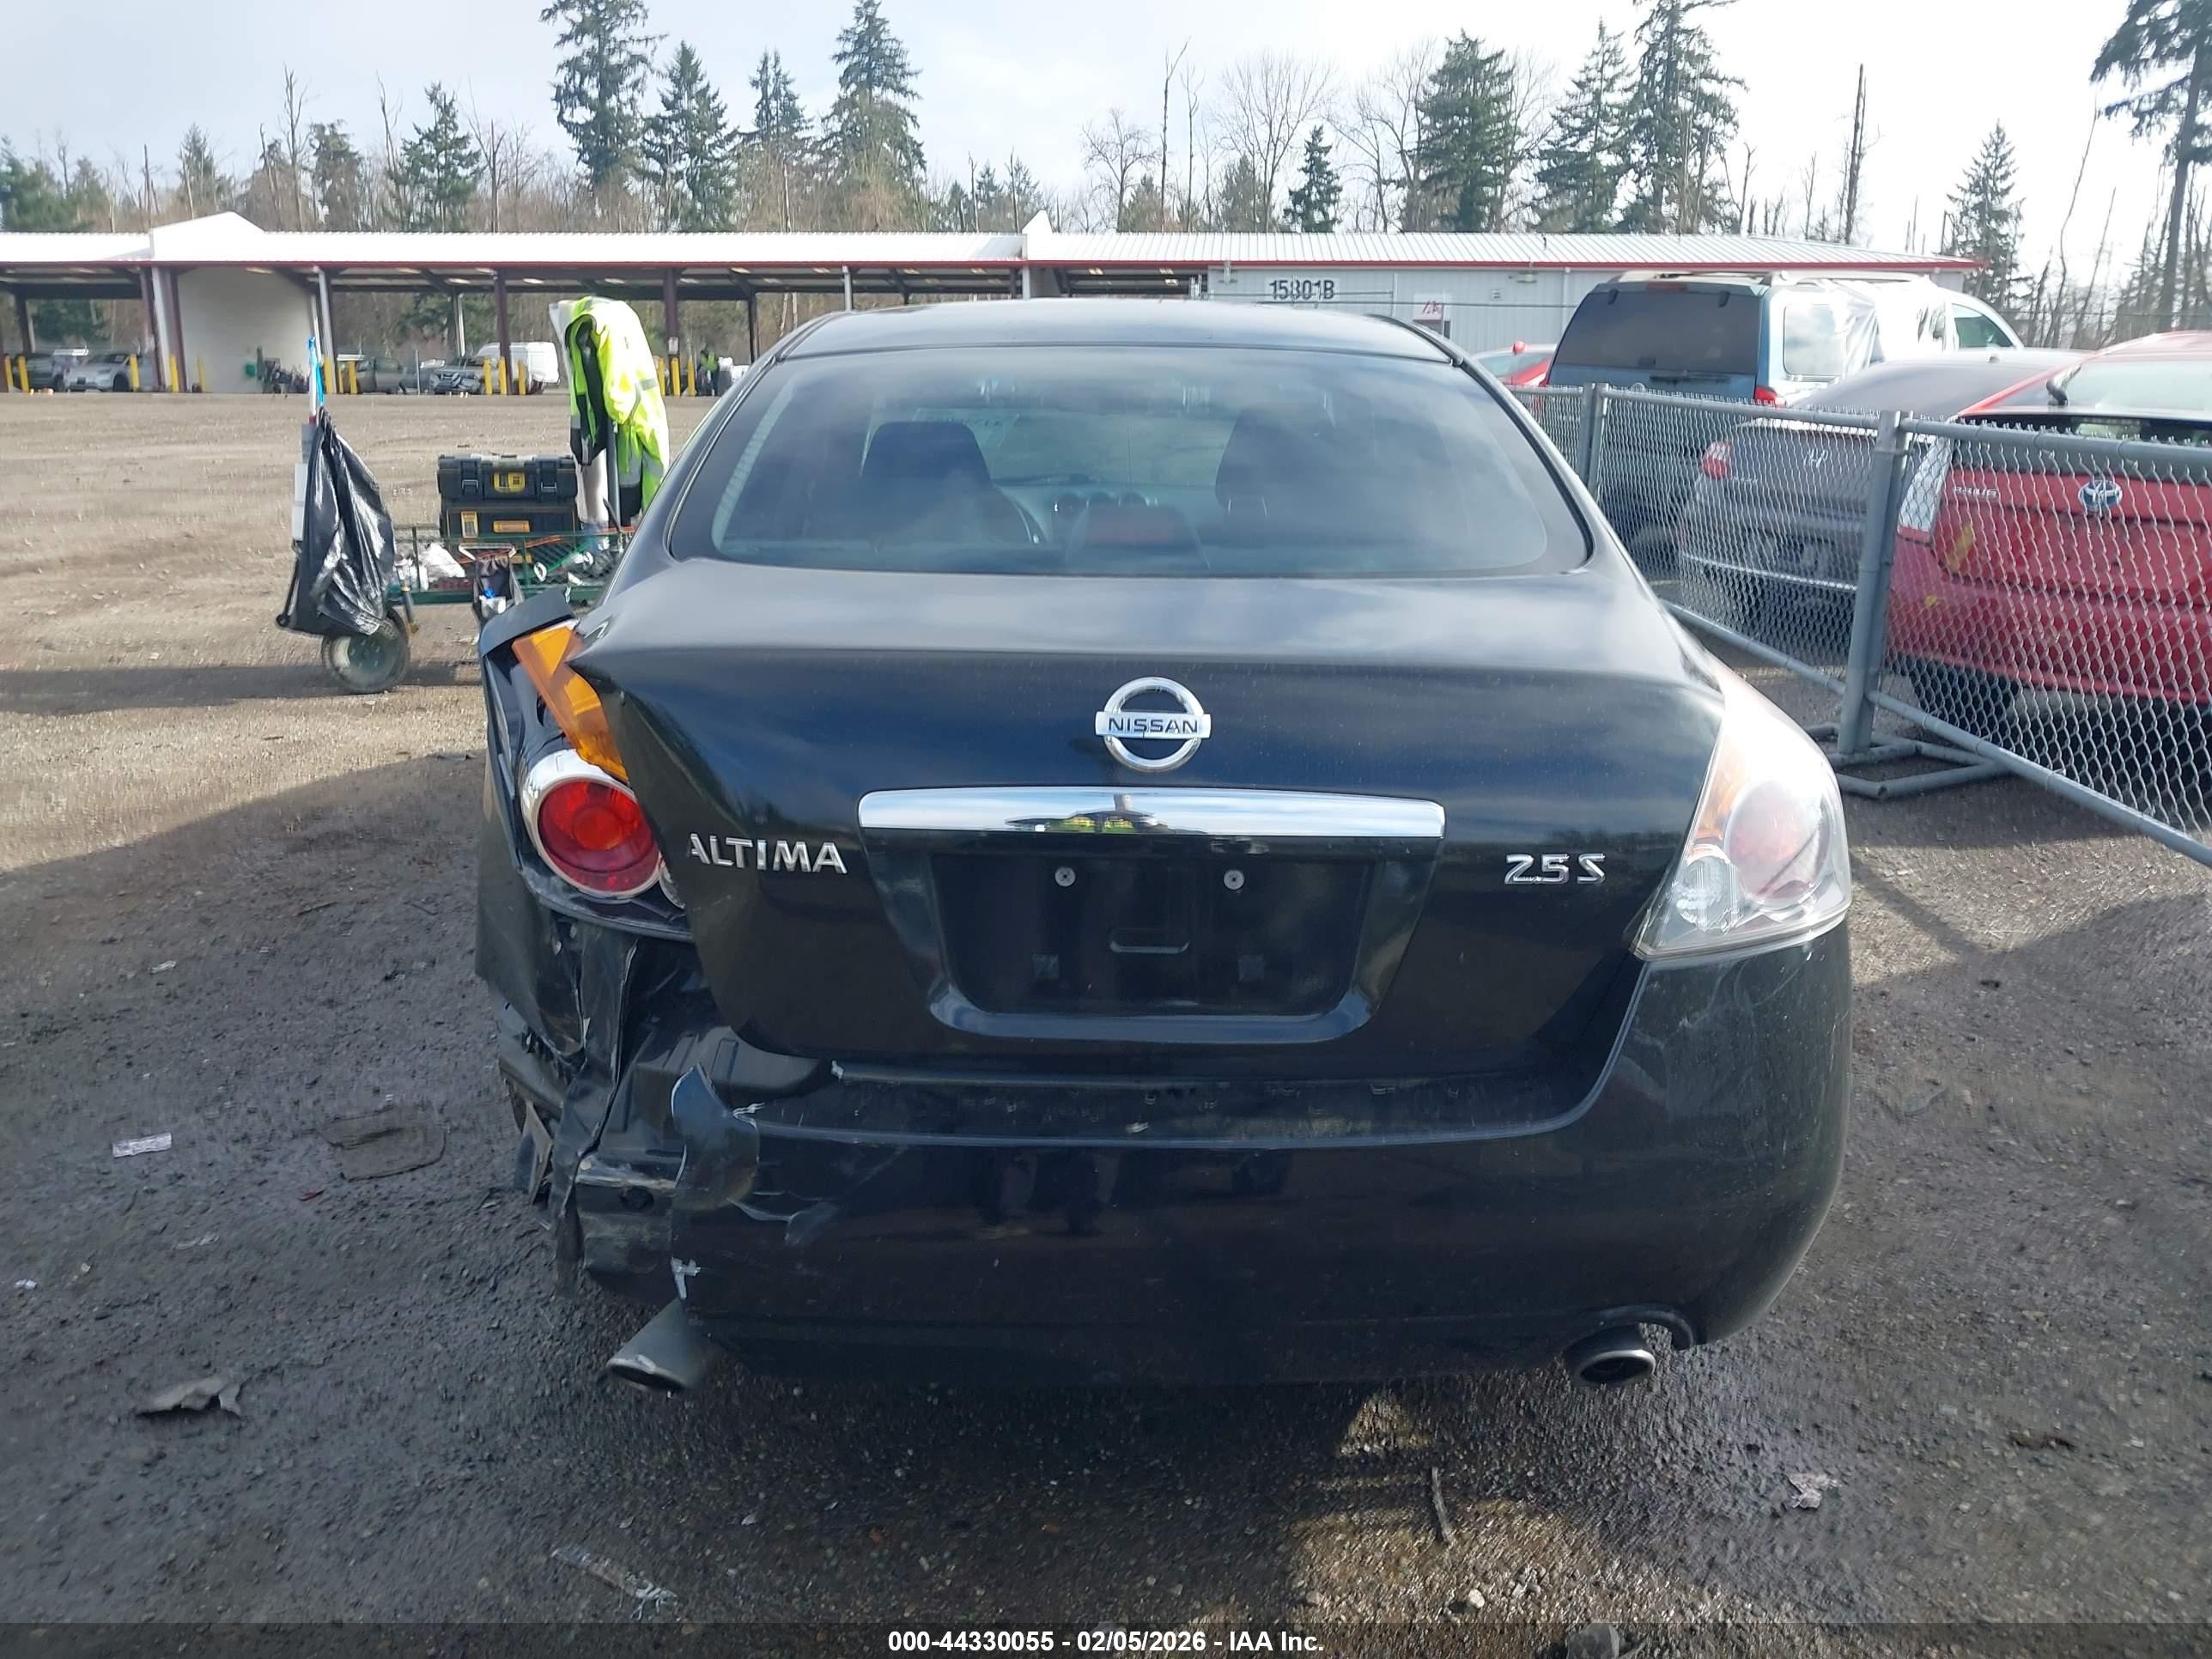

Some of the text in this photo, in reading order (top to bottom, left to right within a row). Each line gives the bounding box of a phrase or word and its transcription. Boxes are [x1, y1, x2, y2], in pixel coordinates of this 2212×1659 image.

[1269, 279, 1334, 300] 15801B
[1109, 717, 1198, 734] NISSAN
[688, 833, 848, 874] ALTIMA
[1577, 853, 1606, 884] S
